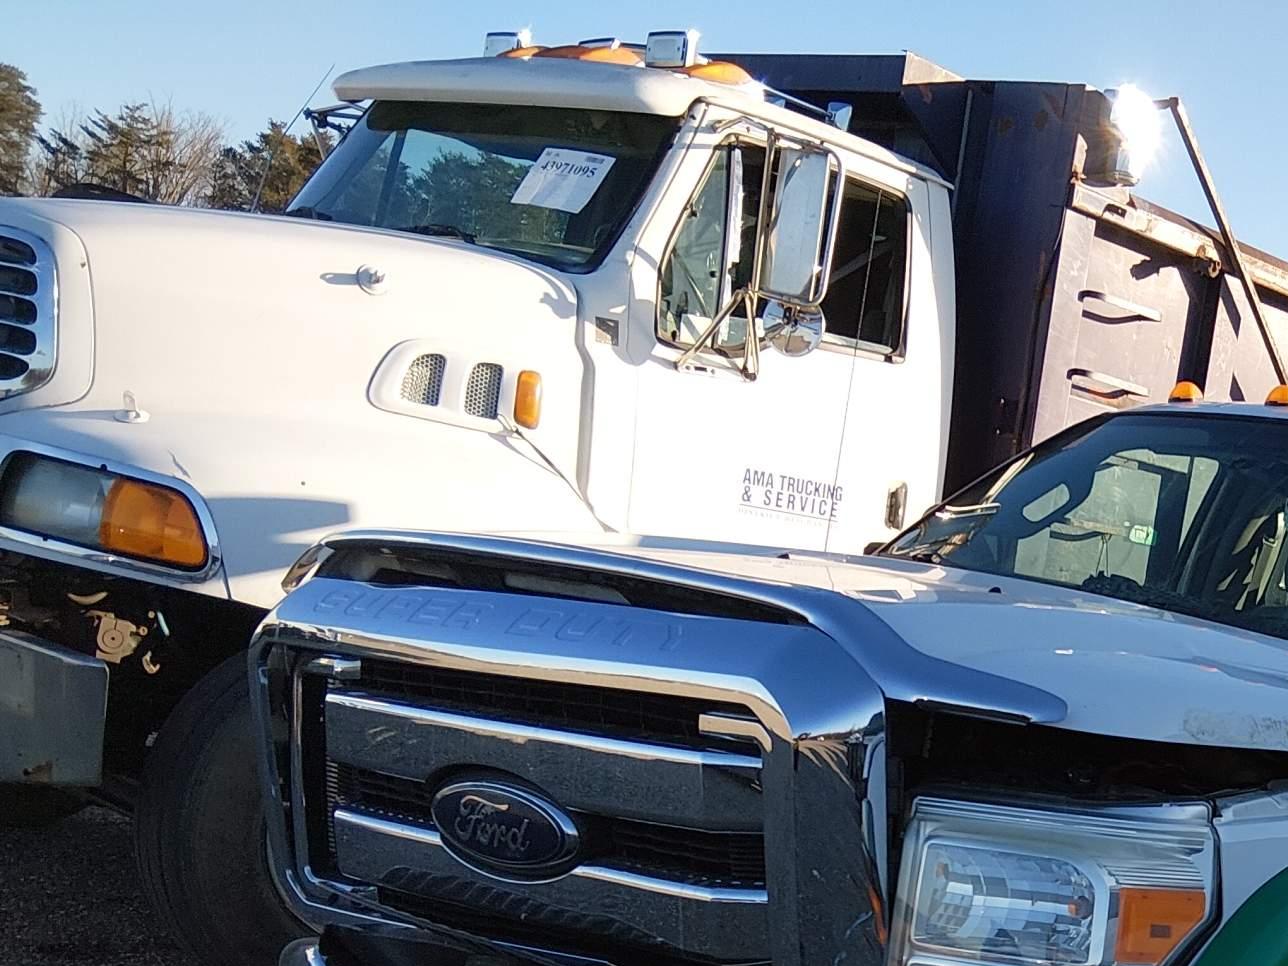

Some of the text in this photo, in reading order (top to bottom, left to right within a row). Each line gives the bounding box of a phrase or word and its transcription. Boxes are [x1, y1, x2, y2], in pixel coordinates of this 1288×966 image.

[741, 485, 752, 502] &
[763, 489, 838, 517] SERVICE
[743, 468, 843, 502] AMA TRUCKING
[312, 589, 686, 651] SUPER DUTY
[454, 795, 531, 851] Ford
